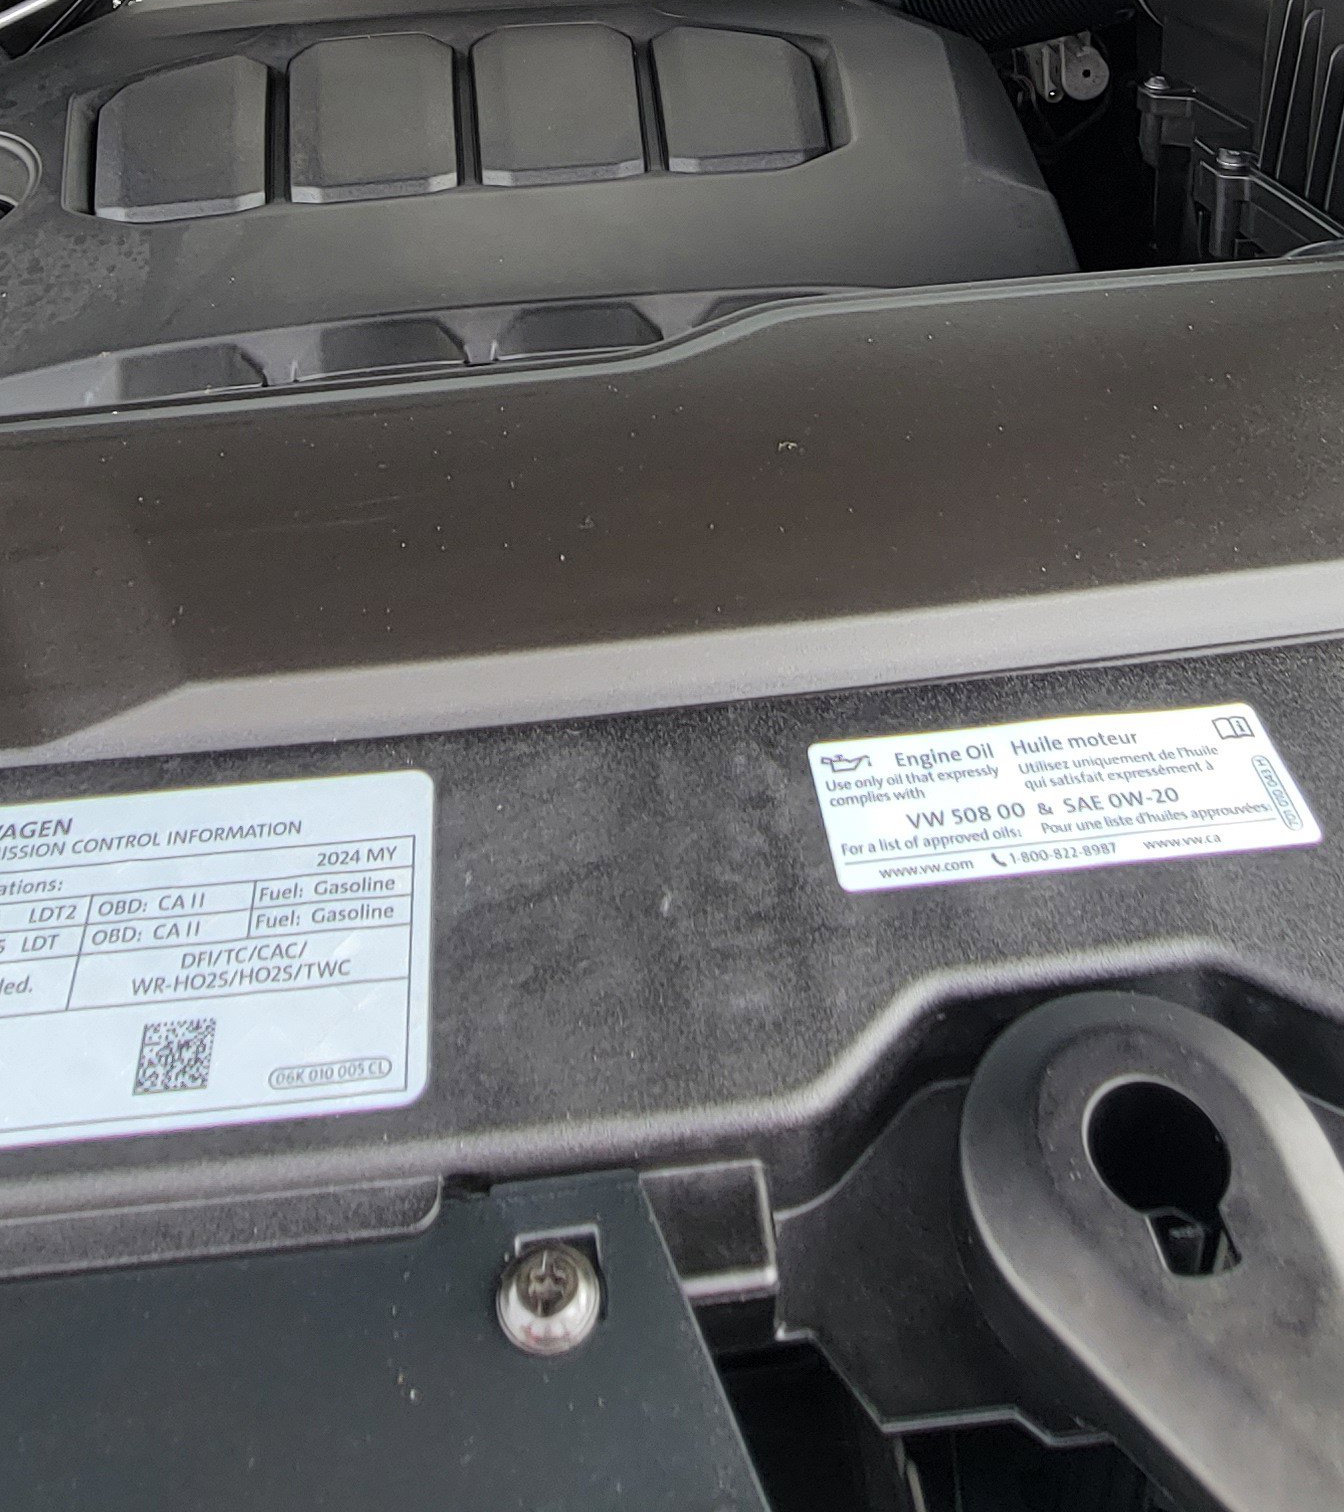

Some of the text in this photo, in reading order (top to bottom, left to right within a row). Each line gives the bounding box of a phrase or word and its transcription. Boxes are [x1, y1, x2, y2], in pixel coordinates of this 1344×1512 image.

[894, 742, 994, 769] Engine Oil
[1010, 731, 1139, 756] Huile moteur
[1018, 744, 1219, 775] Utilisez uniquement de l'huile
[825, 763, 1000, 793] Use only oil that expressly
[1023, 777, 1048, 792] qui
[1049, 769, 1106, 786] satisfait
[829, 787, 926, 808] complies with
[906, 787, 1180, 829] VW 508 00 & SAE 0W-20
[1041, 821, 1074, 835] Pour
[1076, 818, 1103, 832] une
[1105, 812, 1135, 828] liste
[1136, 808, 1188, 825] d'huiles
[71, 831, 160, 854] CONTROL
[166, 819, 302, 844] INFORMATION
[840, 825, 1022, 857] For a list of approved oils:
[1143, 833, 1222, 850] www.vw.ca
[316, 845, 398, 867] 2024 MY
[1009, 842, 1117, 864] 1-800-822-8987
[879, 858, 975, 879] www.vw.com
[258, 876, 395, 902] Fuel: Gasoline
[28, 904, 78, 924] LDT2
[98, 897, 148, 917] OBD:
[157, 894, 185, 912] CA
[255, 904, 394, 931] Fuel: Gasoline
[20, 934, 60, 954] LDT
[91, 926, 142, 946] OBD:
[153, 923, 180, 941] CA
[181, 940, 308, 971] DFI/TC/CAC/
[131, 958, 352, 997] WR-HO2S/HO2S/TWC
